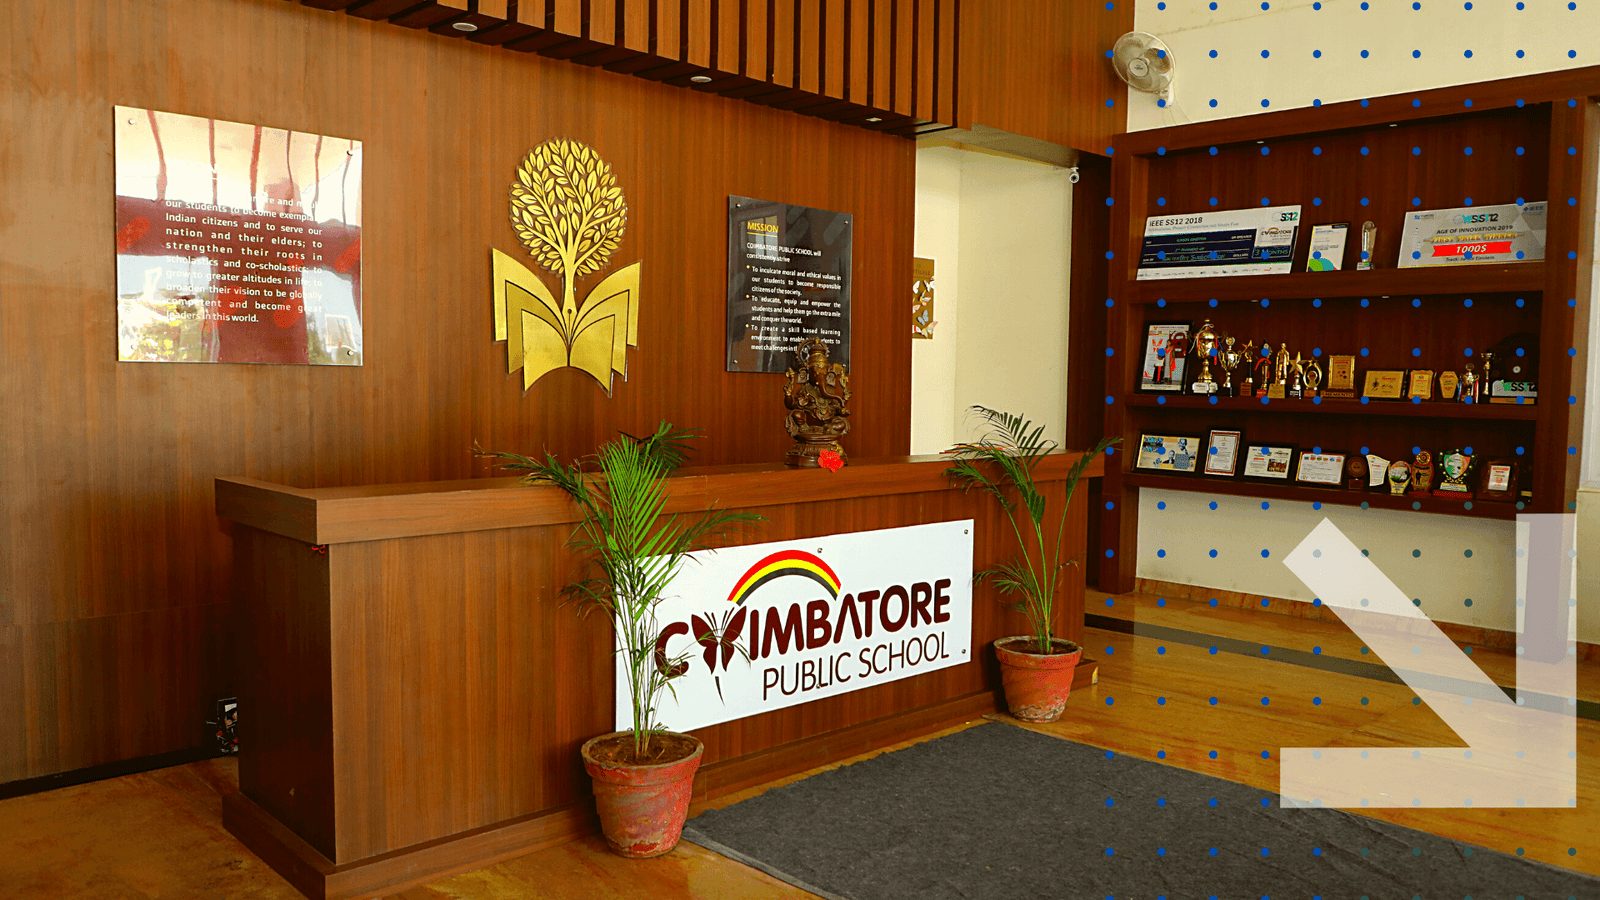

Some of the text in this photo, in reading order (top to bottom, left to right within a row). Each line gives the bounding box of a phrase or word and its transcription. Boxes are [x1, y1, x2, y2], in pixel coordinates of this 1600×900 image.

[277, 198, 294, 207] and
[166, 200, 182, 208] our
[186, 202, 228, 212] students
[243, 208, 277, 218] become
[166, 212, 322, 236] Indian citizens and to serve our
[1166, 218, 1183, 226] SS12
[748, 222, 778, 233] MISSION
[166, 228, 323, 248] nation and their elders; to
[166, 242, 323, 261] strengthen their roots in
[746, 242, 778, 252] COIMBATORE
[778, 246, 795, 254] PUBLIC
[795, 248, 814, 256] SCHOOL
[1456, 244, 1488, 253] 1000$
[166, 255, 219, 267] scholastics
[224, 260, 241, 268] and
[314, 266, 323, 274] to
[760, 267, 781, 275] inculcate
[166, 270, 190, 280] grow
[206, 272, 240, 282] greater
[242, 274, 282, 284] altitudes
[284, 277, 293, 285] in
[166, 283, 206, 293] broaden
[209, 285, 231, 294] their
[234, 287, 260, 296] vision
[276, 289, 287, 298] be
[752, 286, 770, 294] citizens
[229, 301, 248, 309] and
[255, 301, 292, 311] become
[761, 296, 781, 304] educate,
[784, 298, 798, 306] equip
[202, 312, 212, 320] in
[213, 312, 230, 322] this
[232, 314, 259, 322] world.
[821, 328, 841, 336] learning
[764, 344, 788, 352] challenges
[763, 631, 950, 700] PUBLIC SCHOOL
